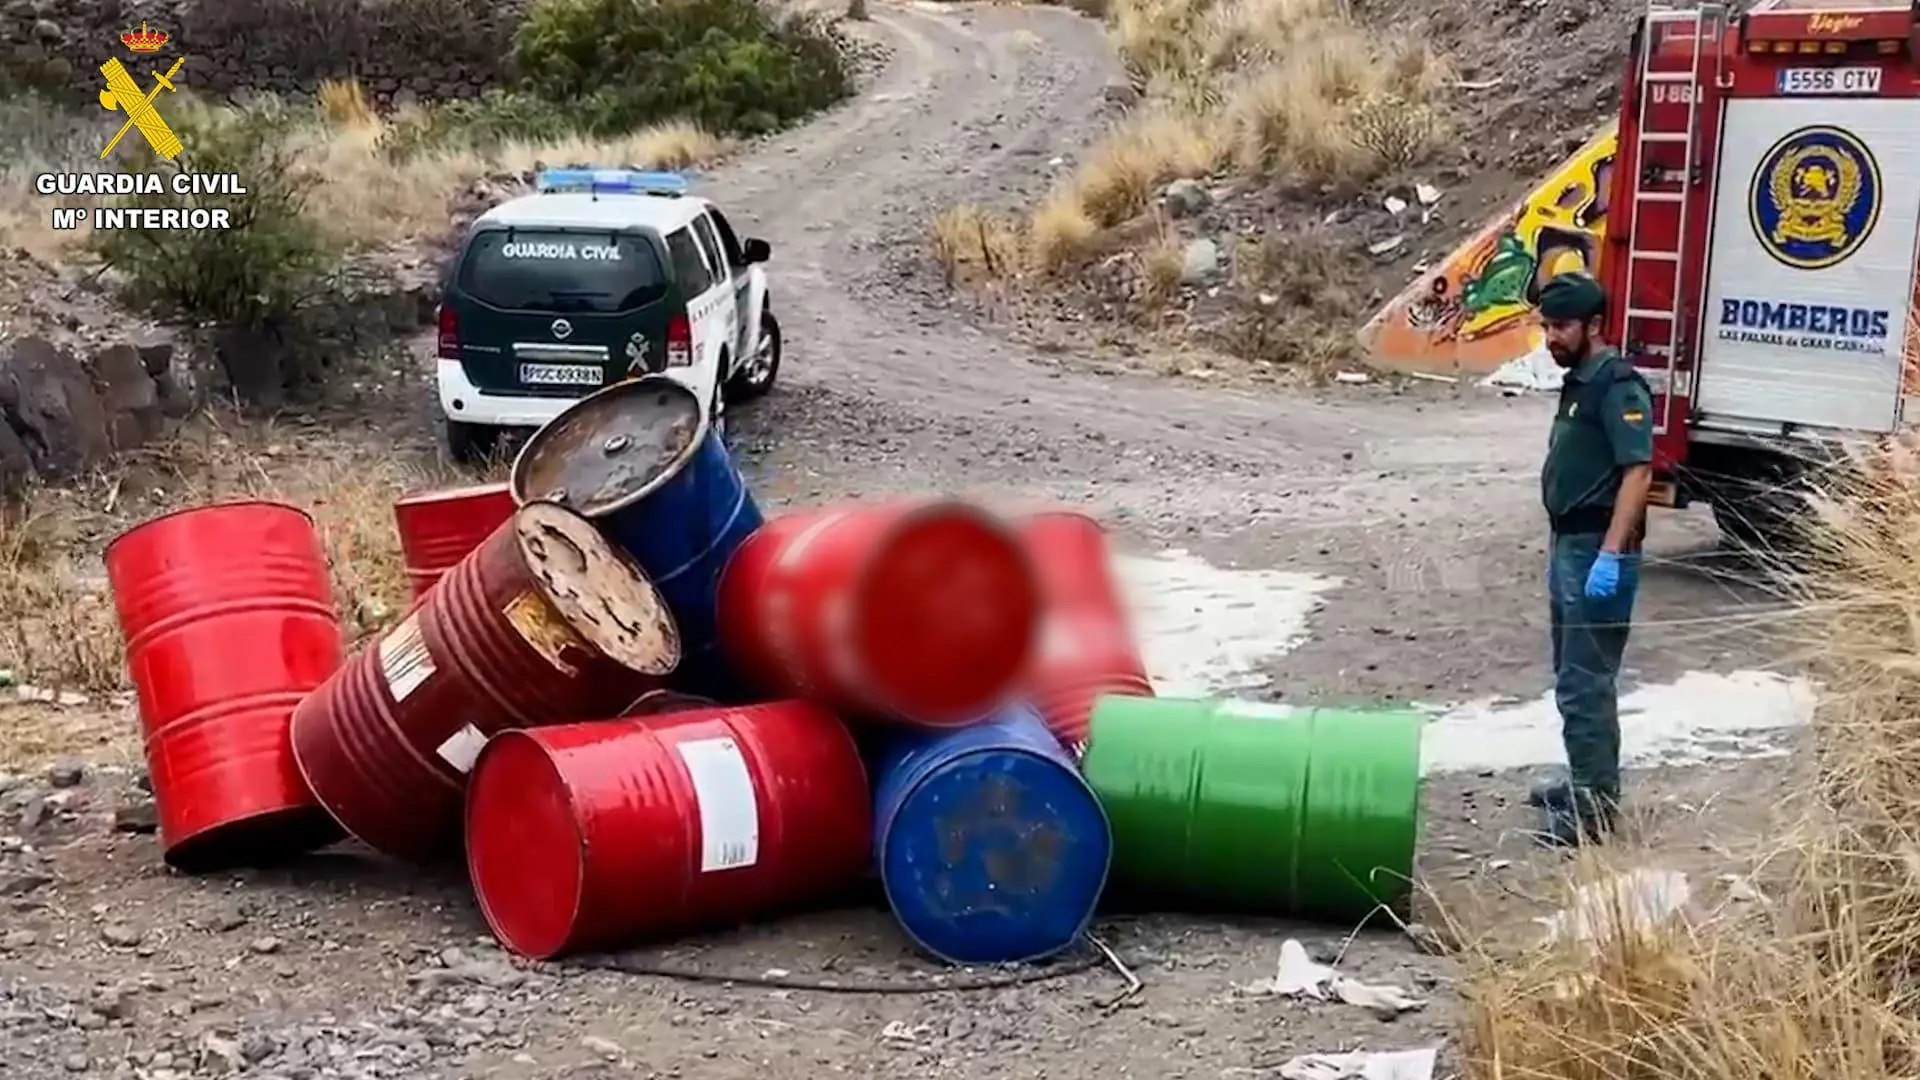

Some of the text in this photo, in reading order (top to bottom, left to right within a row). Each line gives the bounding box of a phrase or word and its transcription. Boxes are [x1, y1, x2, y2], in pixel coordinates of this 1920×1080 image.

[1791, 71, 1834, 89] 5556
[502, 242, 622, 260] GUARDIA CIVIL
[1720, 299, 1889, 338] BOMBEROS
[1741, 333, 1782, 346] PALMAS
[1801, 338, 1831, 349] GRAN
